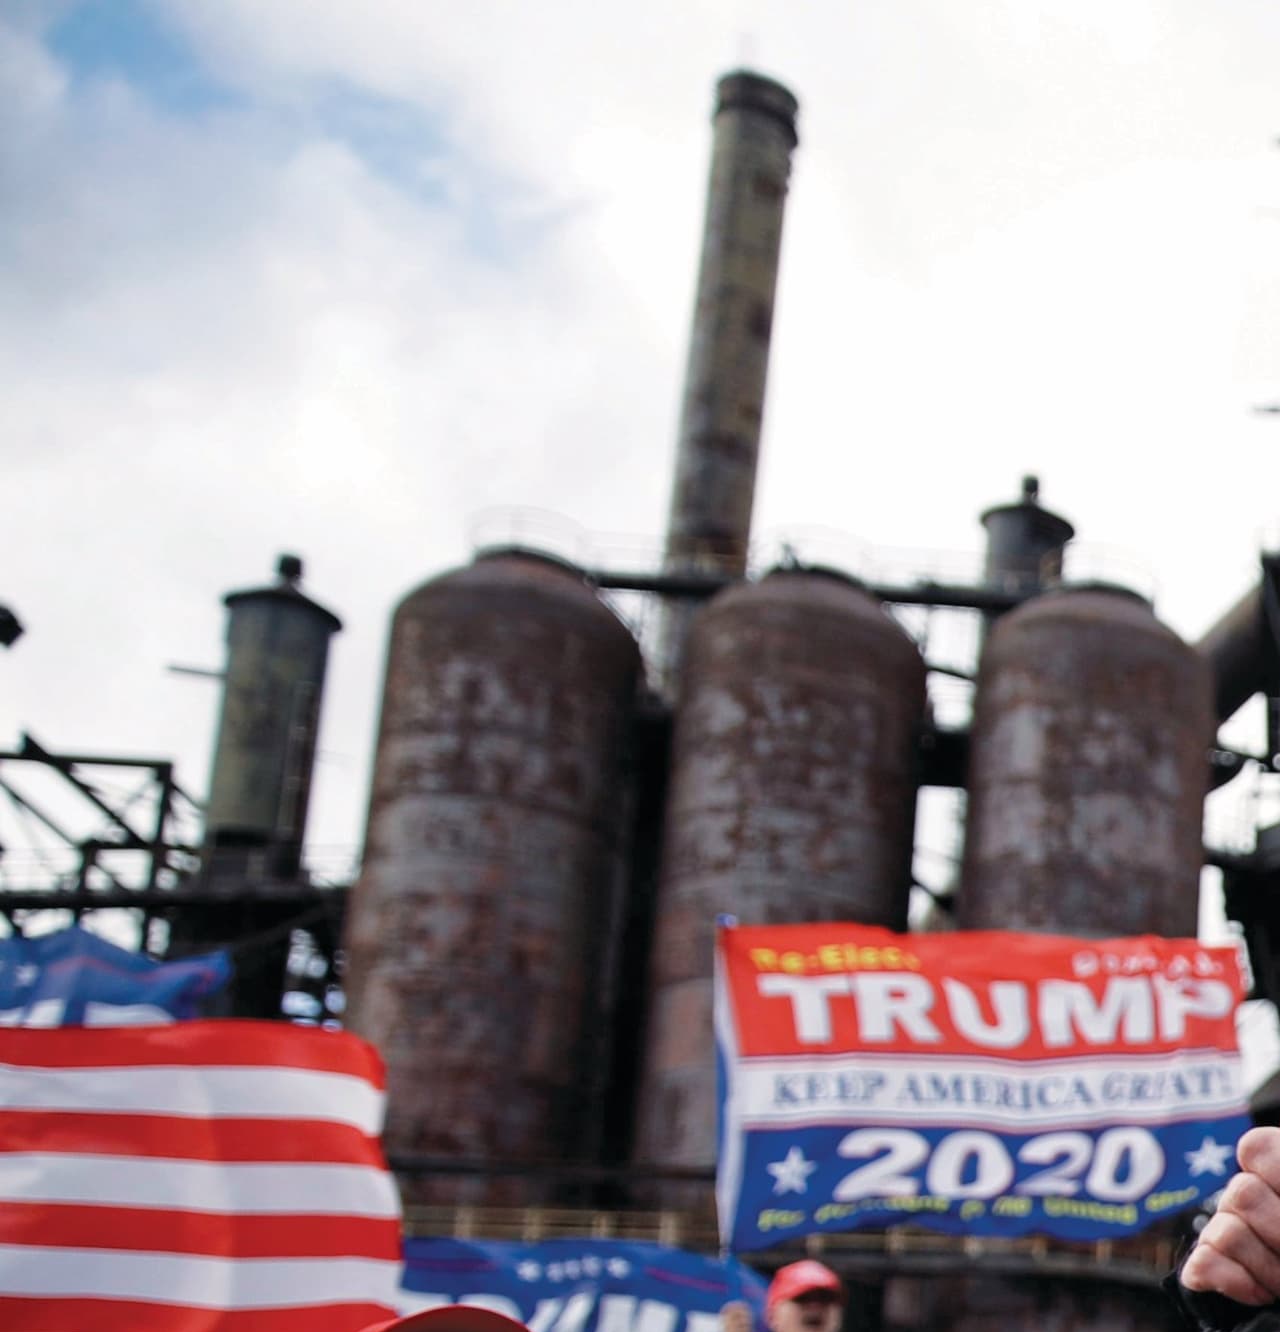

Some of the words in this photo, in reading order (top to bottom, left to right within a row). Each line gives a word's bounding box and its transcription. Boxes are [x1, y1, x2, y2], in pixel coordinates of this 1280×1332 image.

[757, 970, 1235, 1048] TRUMP
[772, 1069, 888, 1106] KEEP
[900, 1067, 1098, 1110] AMERICA
[832, 1126, 1166, 1201] 2020
